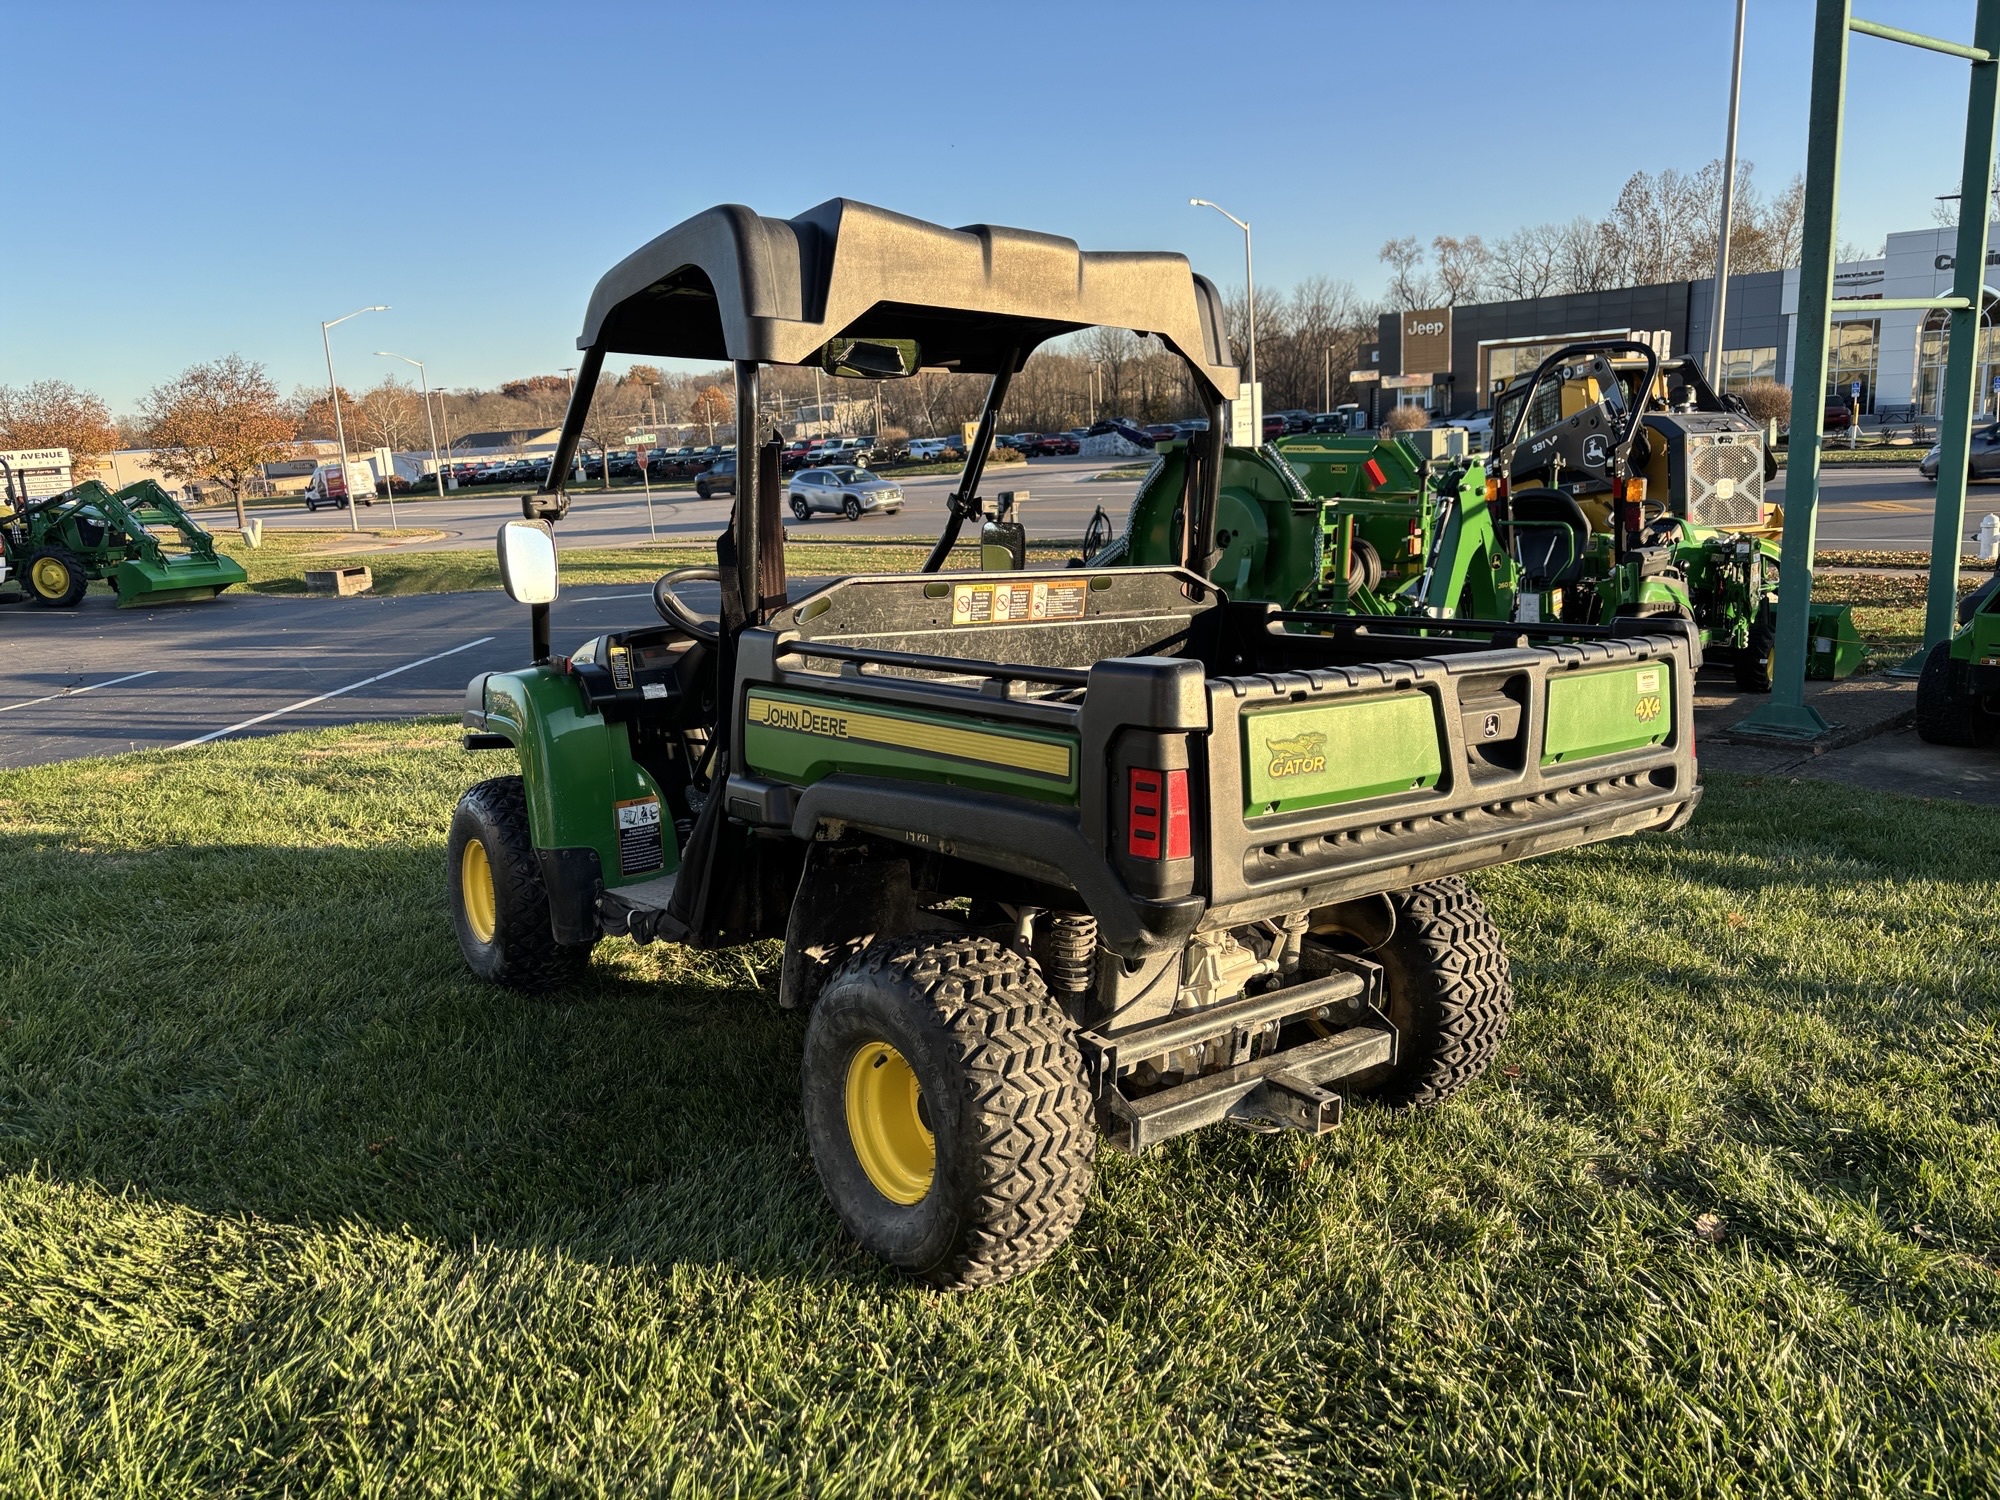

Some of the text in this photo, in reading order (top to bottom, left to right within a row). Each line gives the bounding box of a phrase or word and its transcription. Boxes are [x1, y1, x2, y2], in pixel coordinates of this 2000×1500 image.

[1834, 270, 1885, 279] HRYSLER
[1407, 320, 1444, 336] Jeep
[20, 451, 64, 460] AVENUE
[1531, 440, 1547, 454] 331
[1635, 696, 1661, 720] 4X4
[763, 704, 848, 736] JOHN DEERE
[1269, 756, 1326, 777] GATOR
[890, 1006, 957, 1128] CARLISLE
